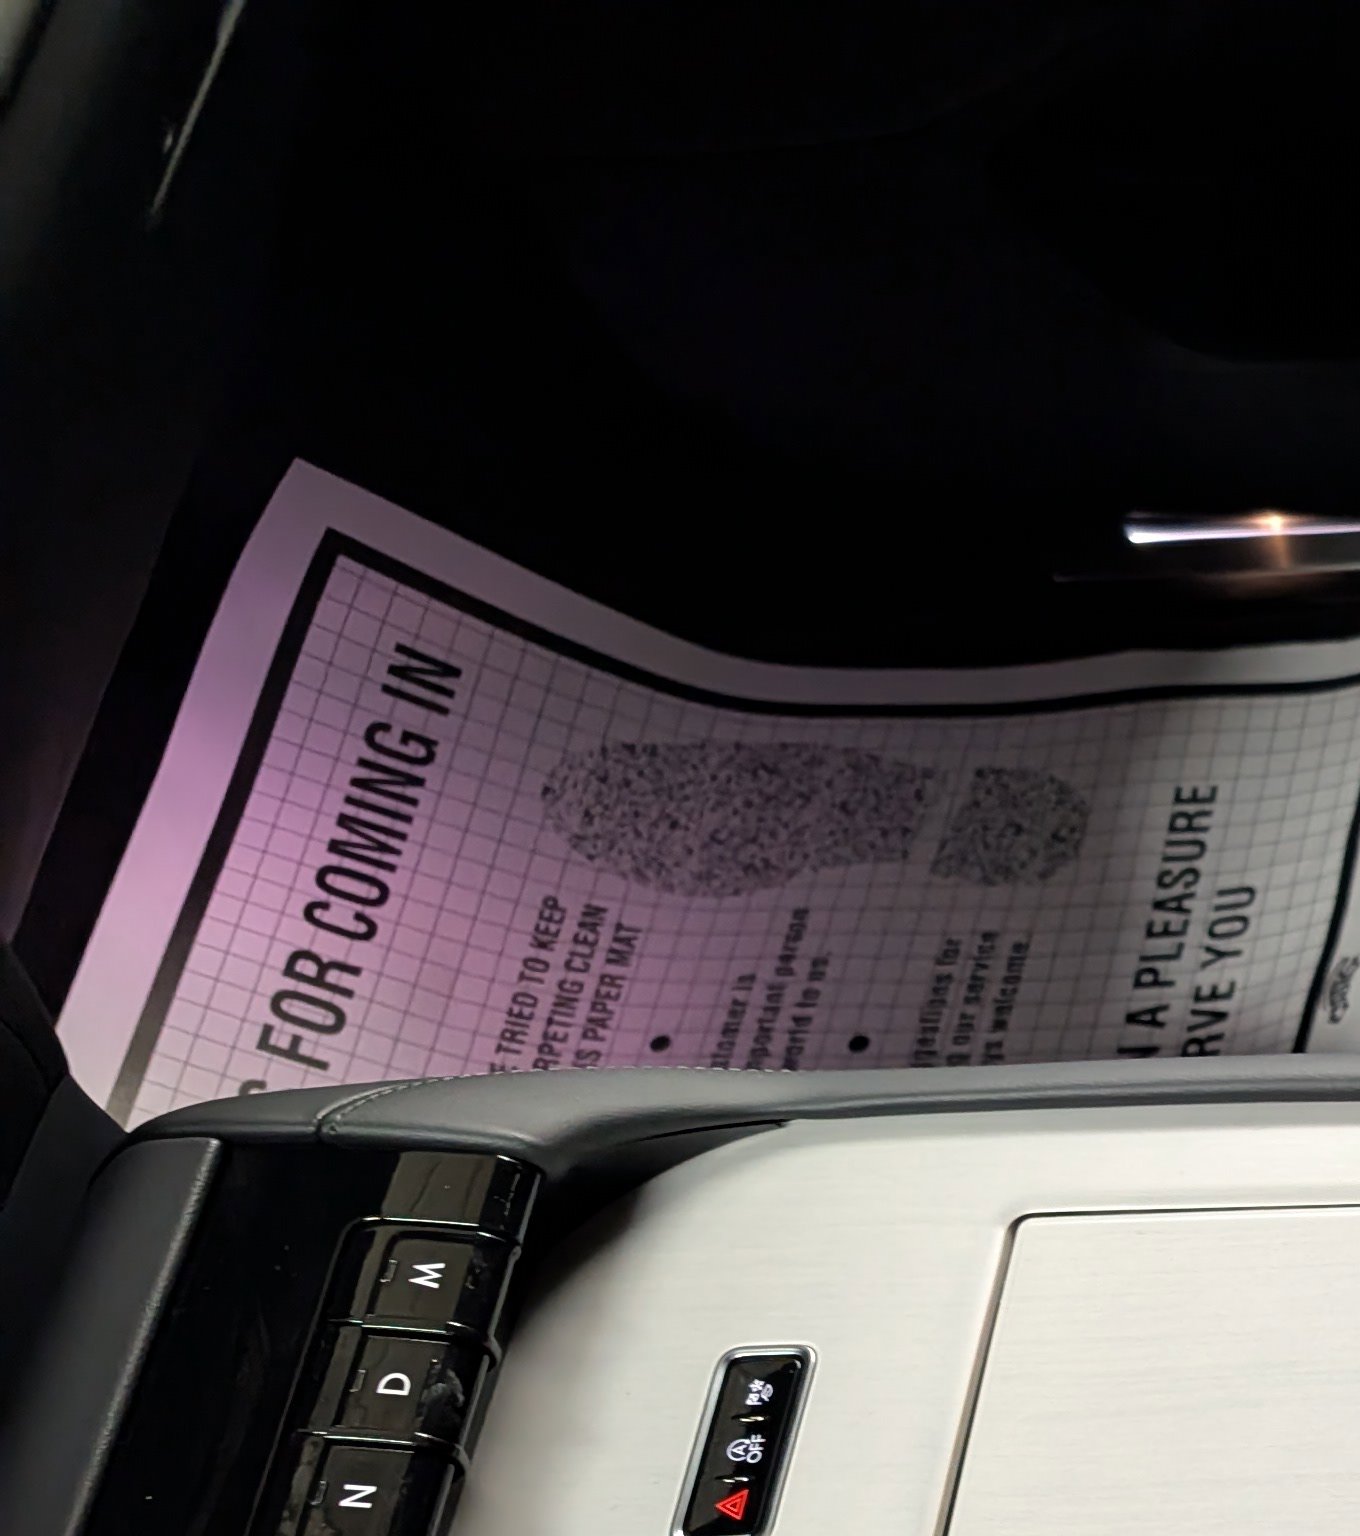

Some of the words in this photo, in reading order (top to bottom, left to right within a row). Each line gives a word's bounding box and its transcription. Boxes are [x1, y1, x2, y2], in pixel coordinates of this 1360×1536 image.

[381, 642, 462, 716] IN
[303, 722, 439, 942] COMING
[1132, 785, 1219, 990] PLEASURE
[529, 895, 567, 952] KEEP
[564, 903, 609, 974] CLEAN
[775, 908, 810, 977] person
[934, 938, 962, 965] for
[1201, 886, 1257, 972] YOU
[517, 957, 550, 985] TO
[582, 974, 627, 1043] PAPER
[605, 922, 643, 967] MAT
[732, 973, 756, 991] is
[794, 988, 821, 1008] to
[952, 1012, 976, 1046] our
[964, 930, 999, 1005] service
[256, 950, 363, 1072] FOR
[495, 992, 539, 1055] TRIED
[1125, 1003, 1170, 1029] A
[408, 1262, 446, 1289] M
[376, 1371, 411, 1397] D
[746, 1434, 767, 1464] OFF
[338, 1484, 378, 1509] N
